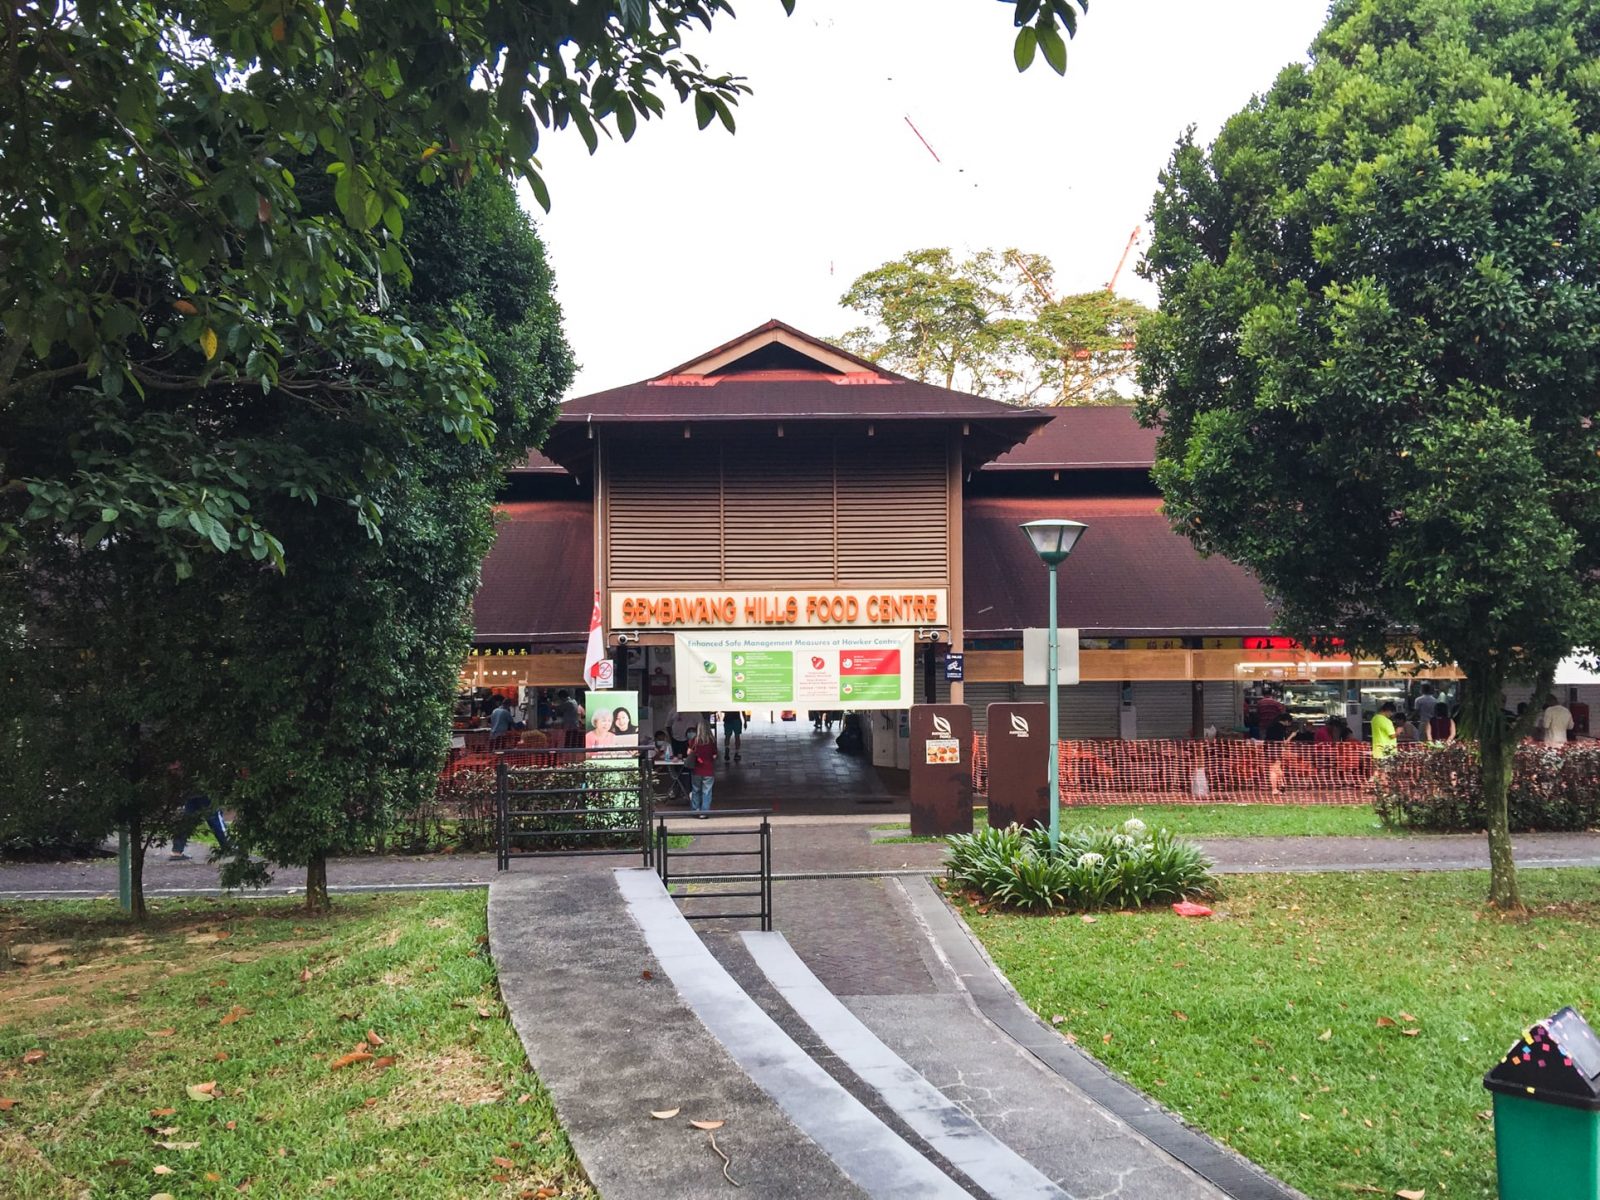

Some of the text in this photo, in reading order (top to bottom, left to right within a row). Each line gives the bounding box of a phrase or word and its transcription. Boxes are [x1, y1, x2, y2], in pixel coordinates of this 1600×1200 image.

[622, 594, 937, 625] SEMBAWANG HILLS FOOD CENTRE
[744, 640, 793, 648] Management
